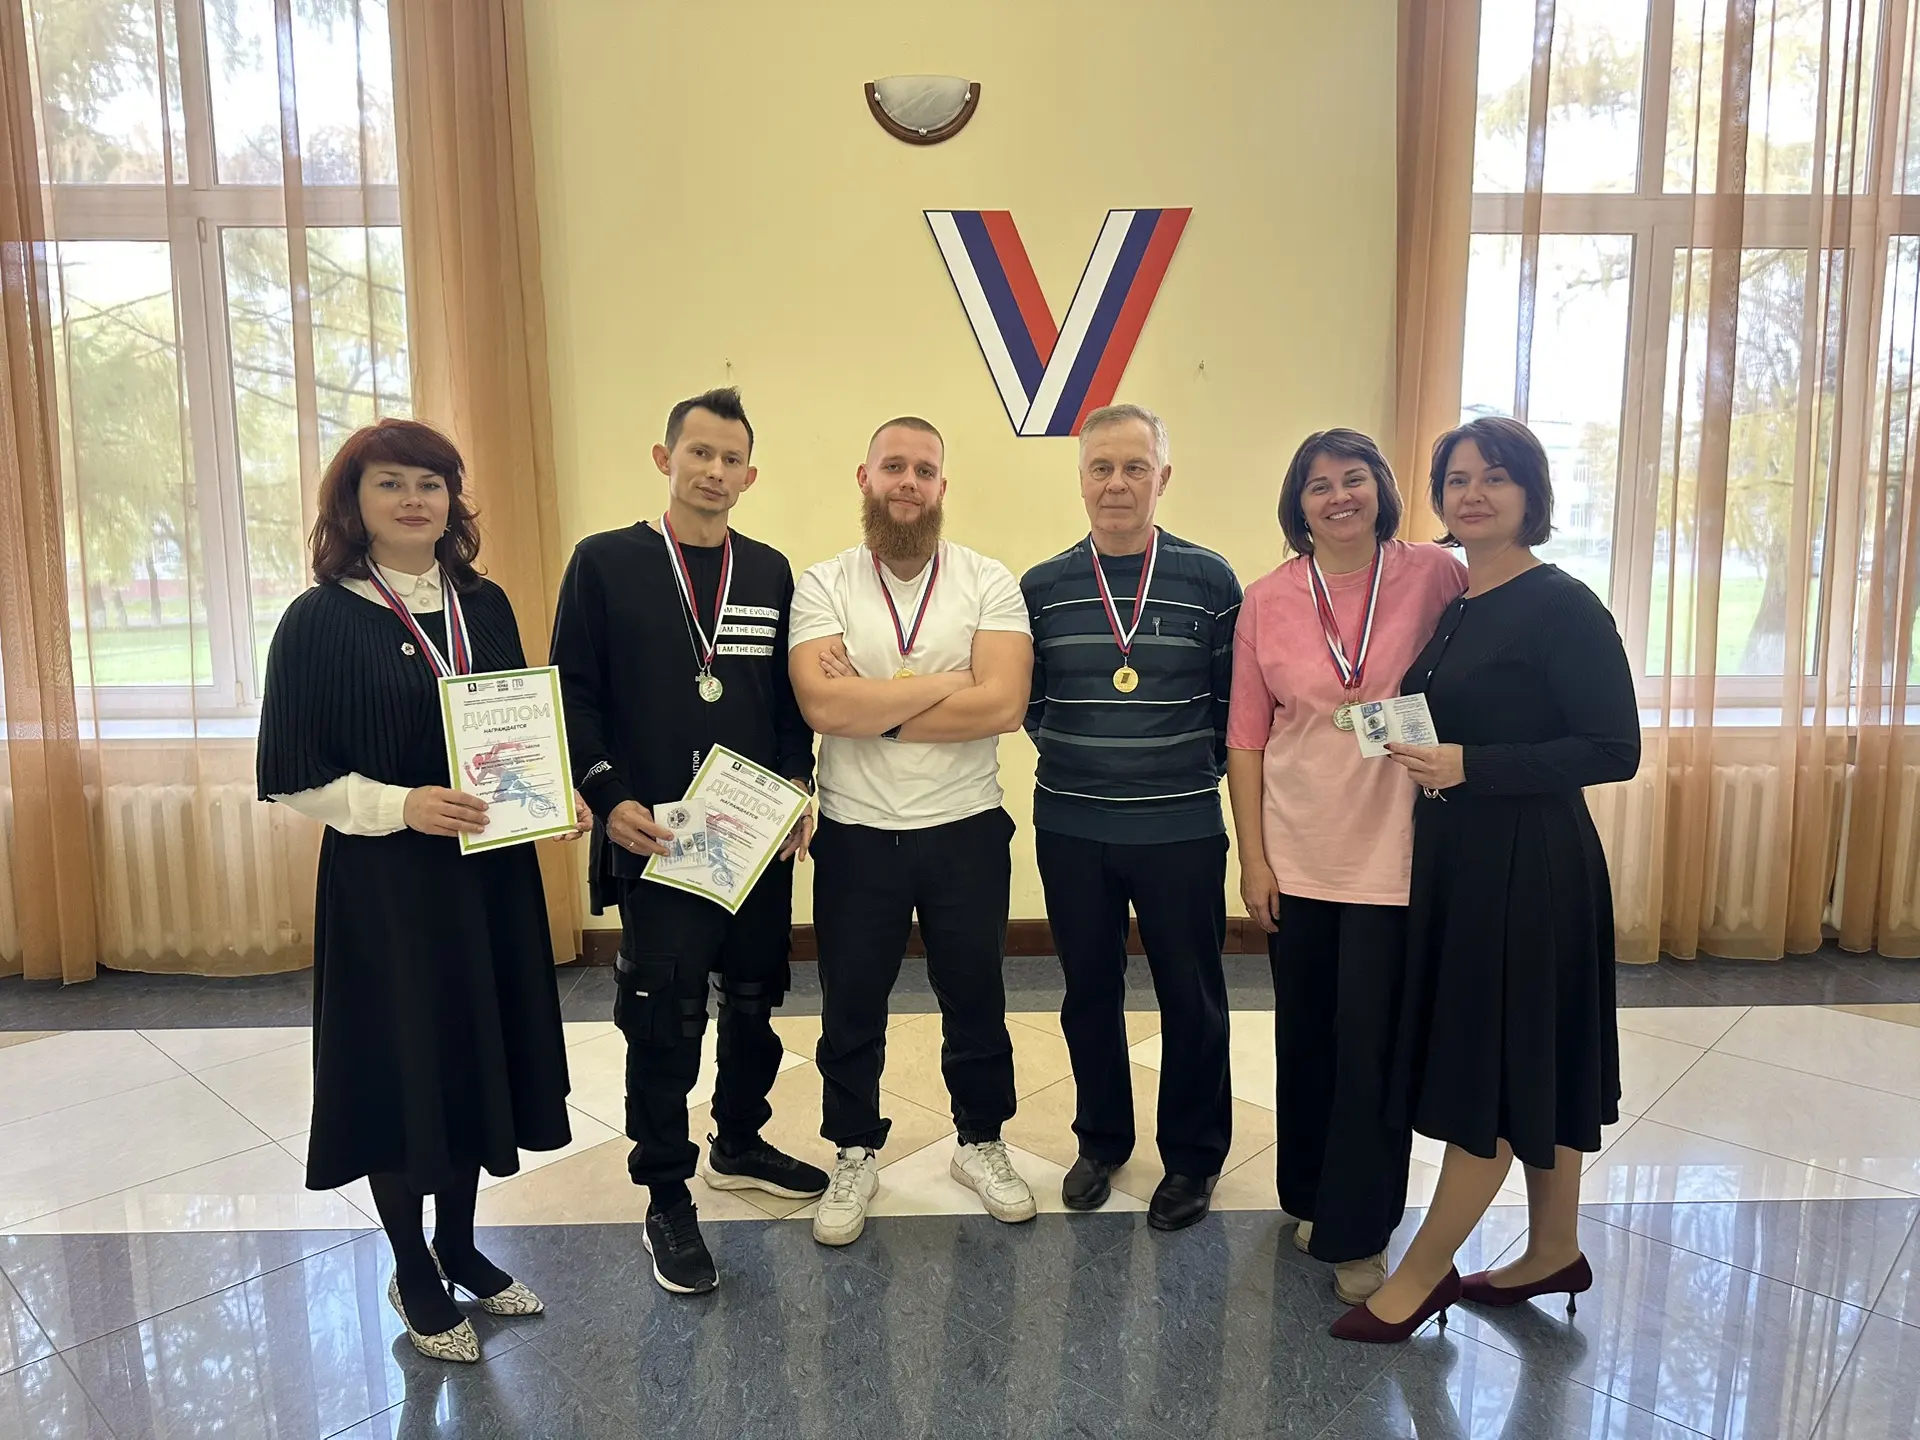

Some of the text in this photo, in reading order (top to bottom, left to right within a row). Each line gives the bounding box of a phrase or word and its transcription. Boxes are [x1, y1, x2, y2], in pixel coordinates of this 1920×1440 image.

[735, 607, 748, 615] THE
[736, 626, 748, 634] THE
[462, 703, 550, 732] ДИПЛОМ
[483, 723, 527, 734] НАГРАЖДАЕТСЯ
[706, 778, 785, 826] ДИПЛОМ
[720, 798, 758, 820] НАГРАЖДАЕТСЯ
